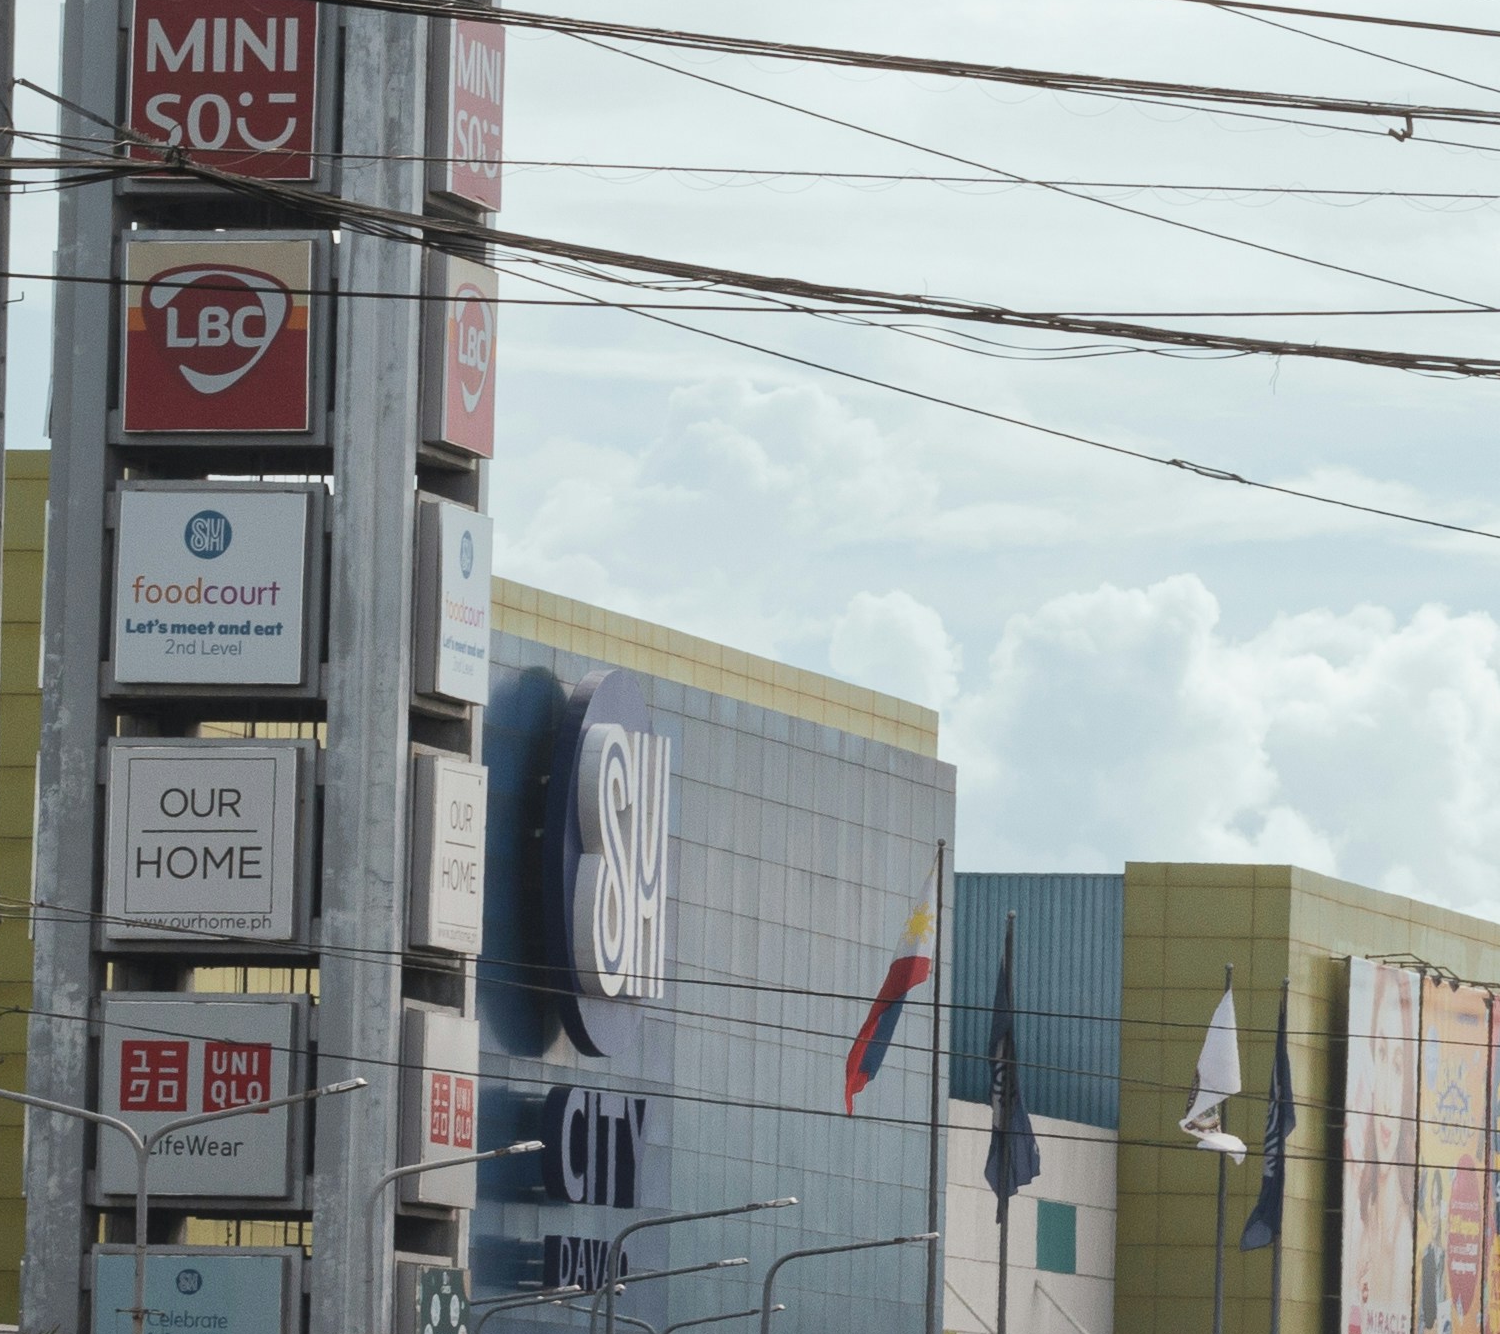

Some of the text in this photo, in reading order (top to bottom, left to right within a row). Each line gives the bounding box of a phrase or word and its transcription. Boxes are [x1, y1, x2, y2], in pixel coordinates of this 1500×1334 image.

[145, 18, 299, 72] MINI
[455, 39, 503, 108] MINI
[166, 304, 270, 350] LBC
[457, 317, 487, 369] LBC
[189, 518, 225, 553] SM
[132, 576, 281, 606] foodcourt
[170, 620, 215, 636] meet
[217, 619, 252, 636] and
[254, 621, 283, 636] eat
[445, 590, 485, 631] foodcourt
[164, 638, 243, 656] 2nd Level
[159, 787, 242, 818] OUR
[450, 800, 472, 834] OUR
[135, 846, 263, 880] HOME
[441, 858, 477, 895] HOME
[592, 722, 673, 998] SM
[211, 1050, 260, 1076] UNI
[560, 1087, 650, 1208] CITY
